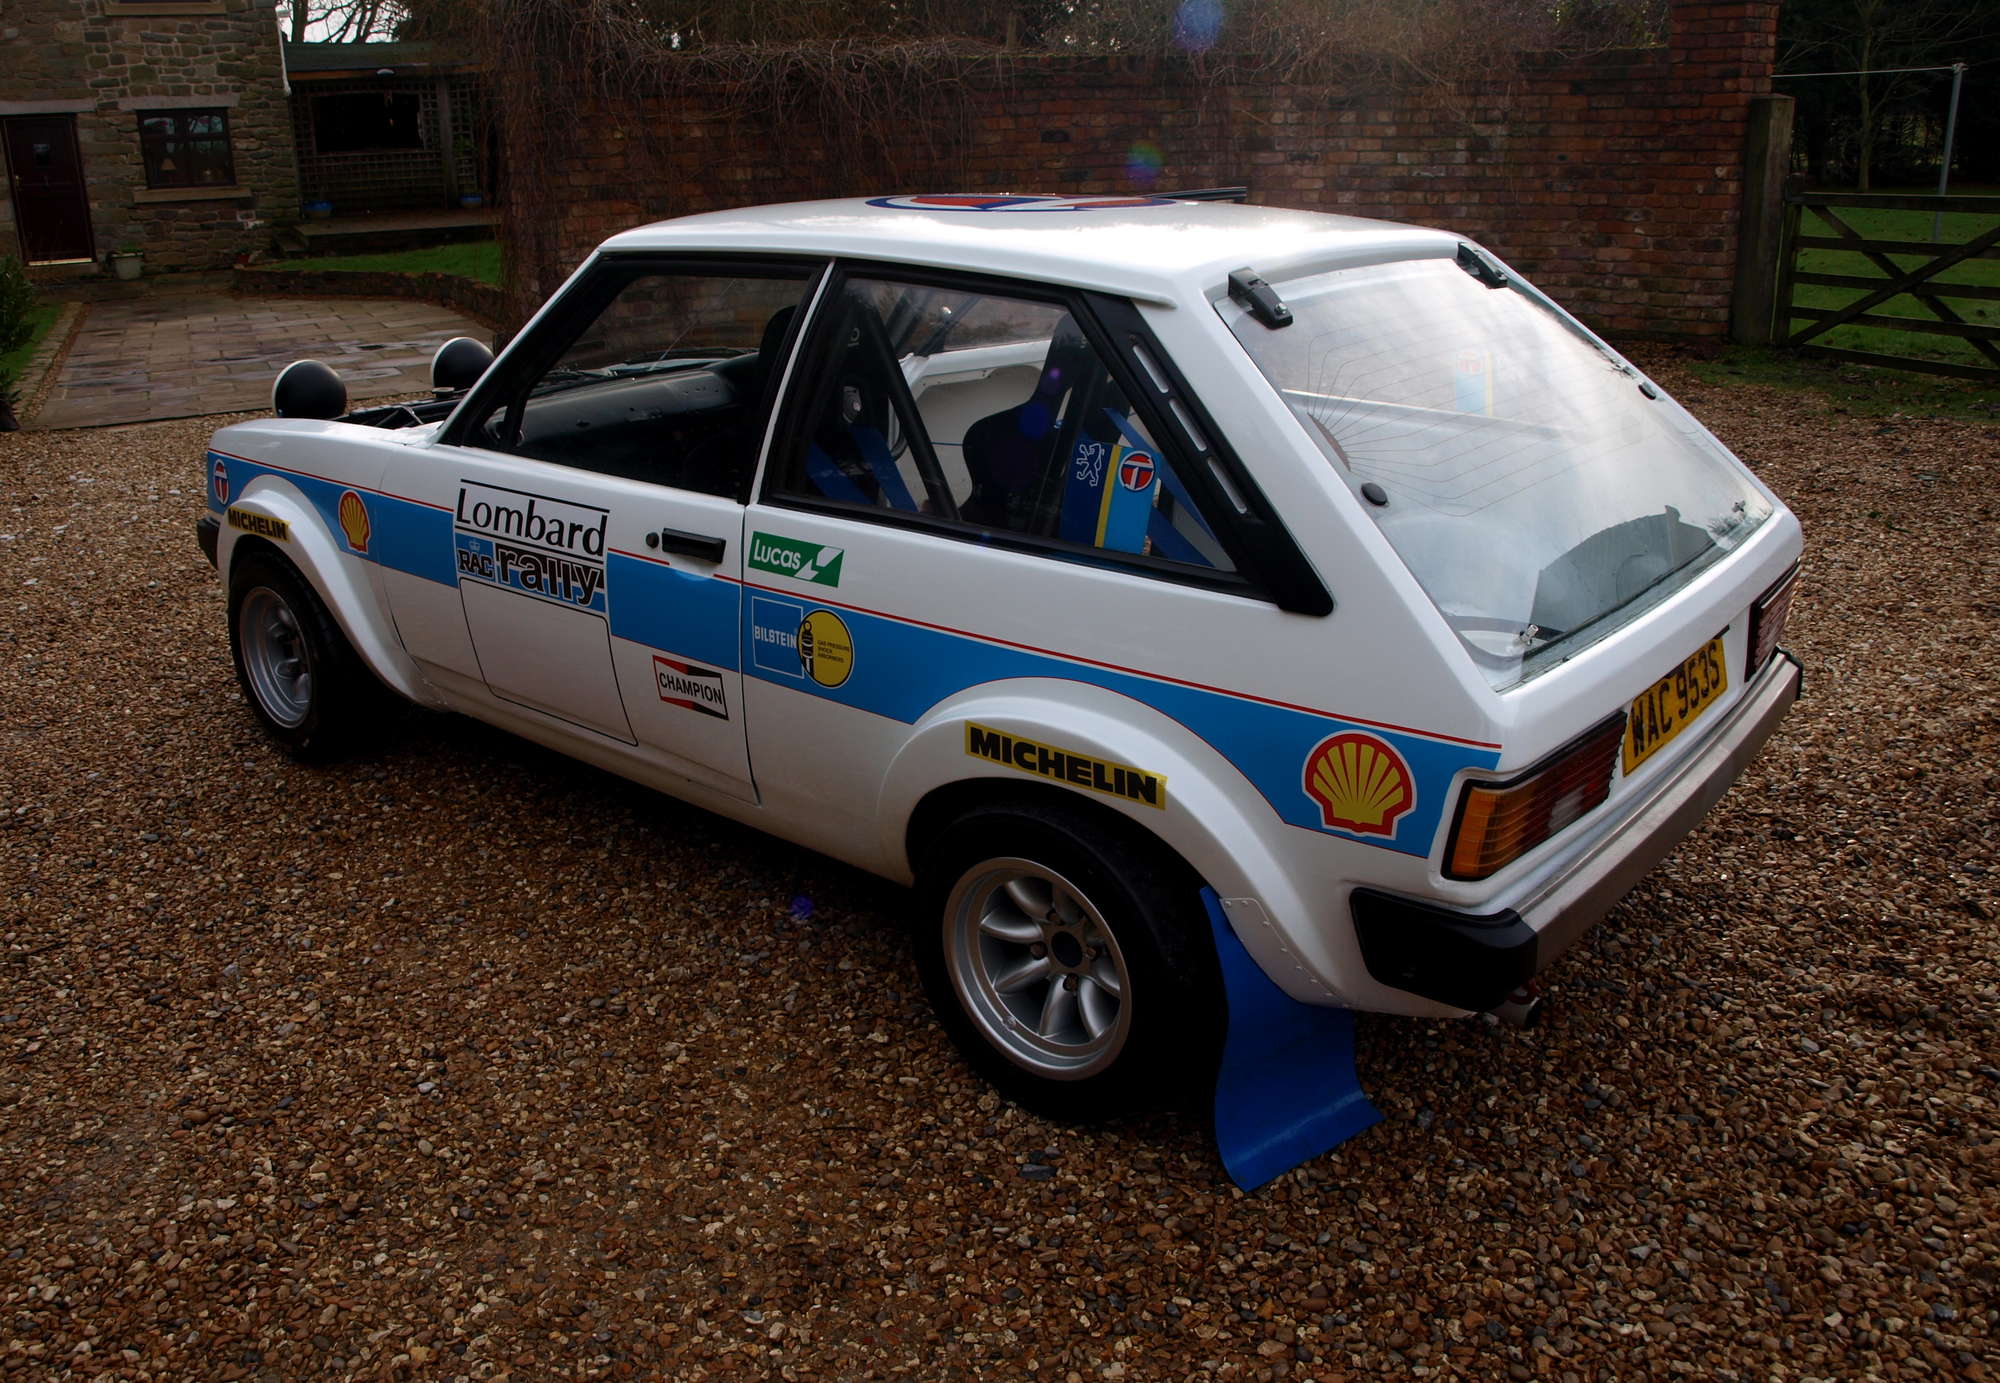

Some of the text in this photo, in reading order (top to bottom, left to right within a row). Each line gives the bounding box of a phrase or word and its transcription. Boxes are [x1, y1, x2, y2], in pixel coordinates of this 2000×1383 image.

[227, 507, 289, 541] MICHELIN
[457, 488, 608, 557] Lombard
[457, 547, 602, 606] RAC rally
[754, 624, 798, 649] BILSTEIN
[659, 672, 723, 705] CHAMPION
[1630, 640, 1720, 758] WAC 953S
[970, 726, 1157, 804] MICHELIN
